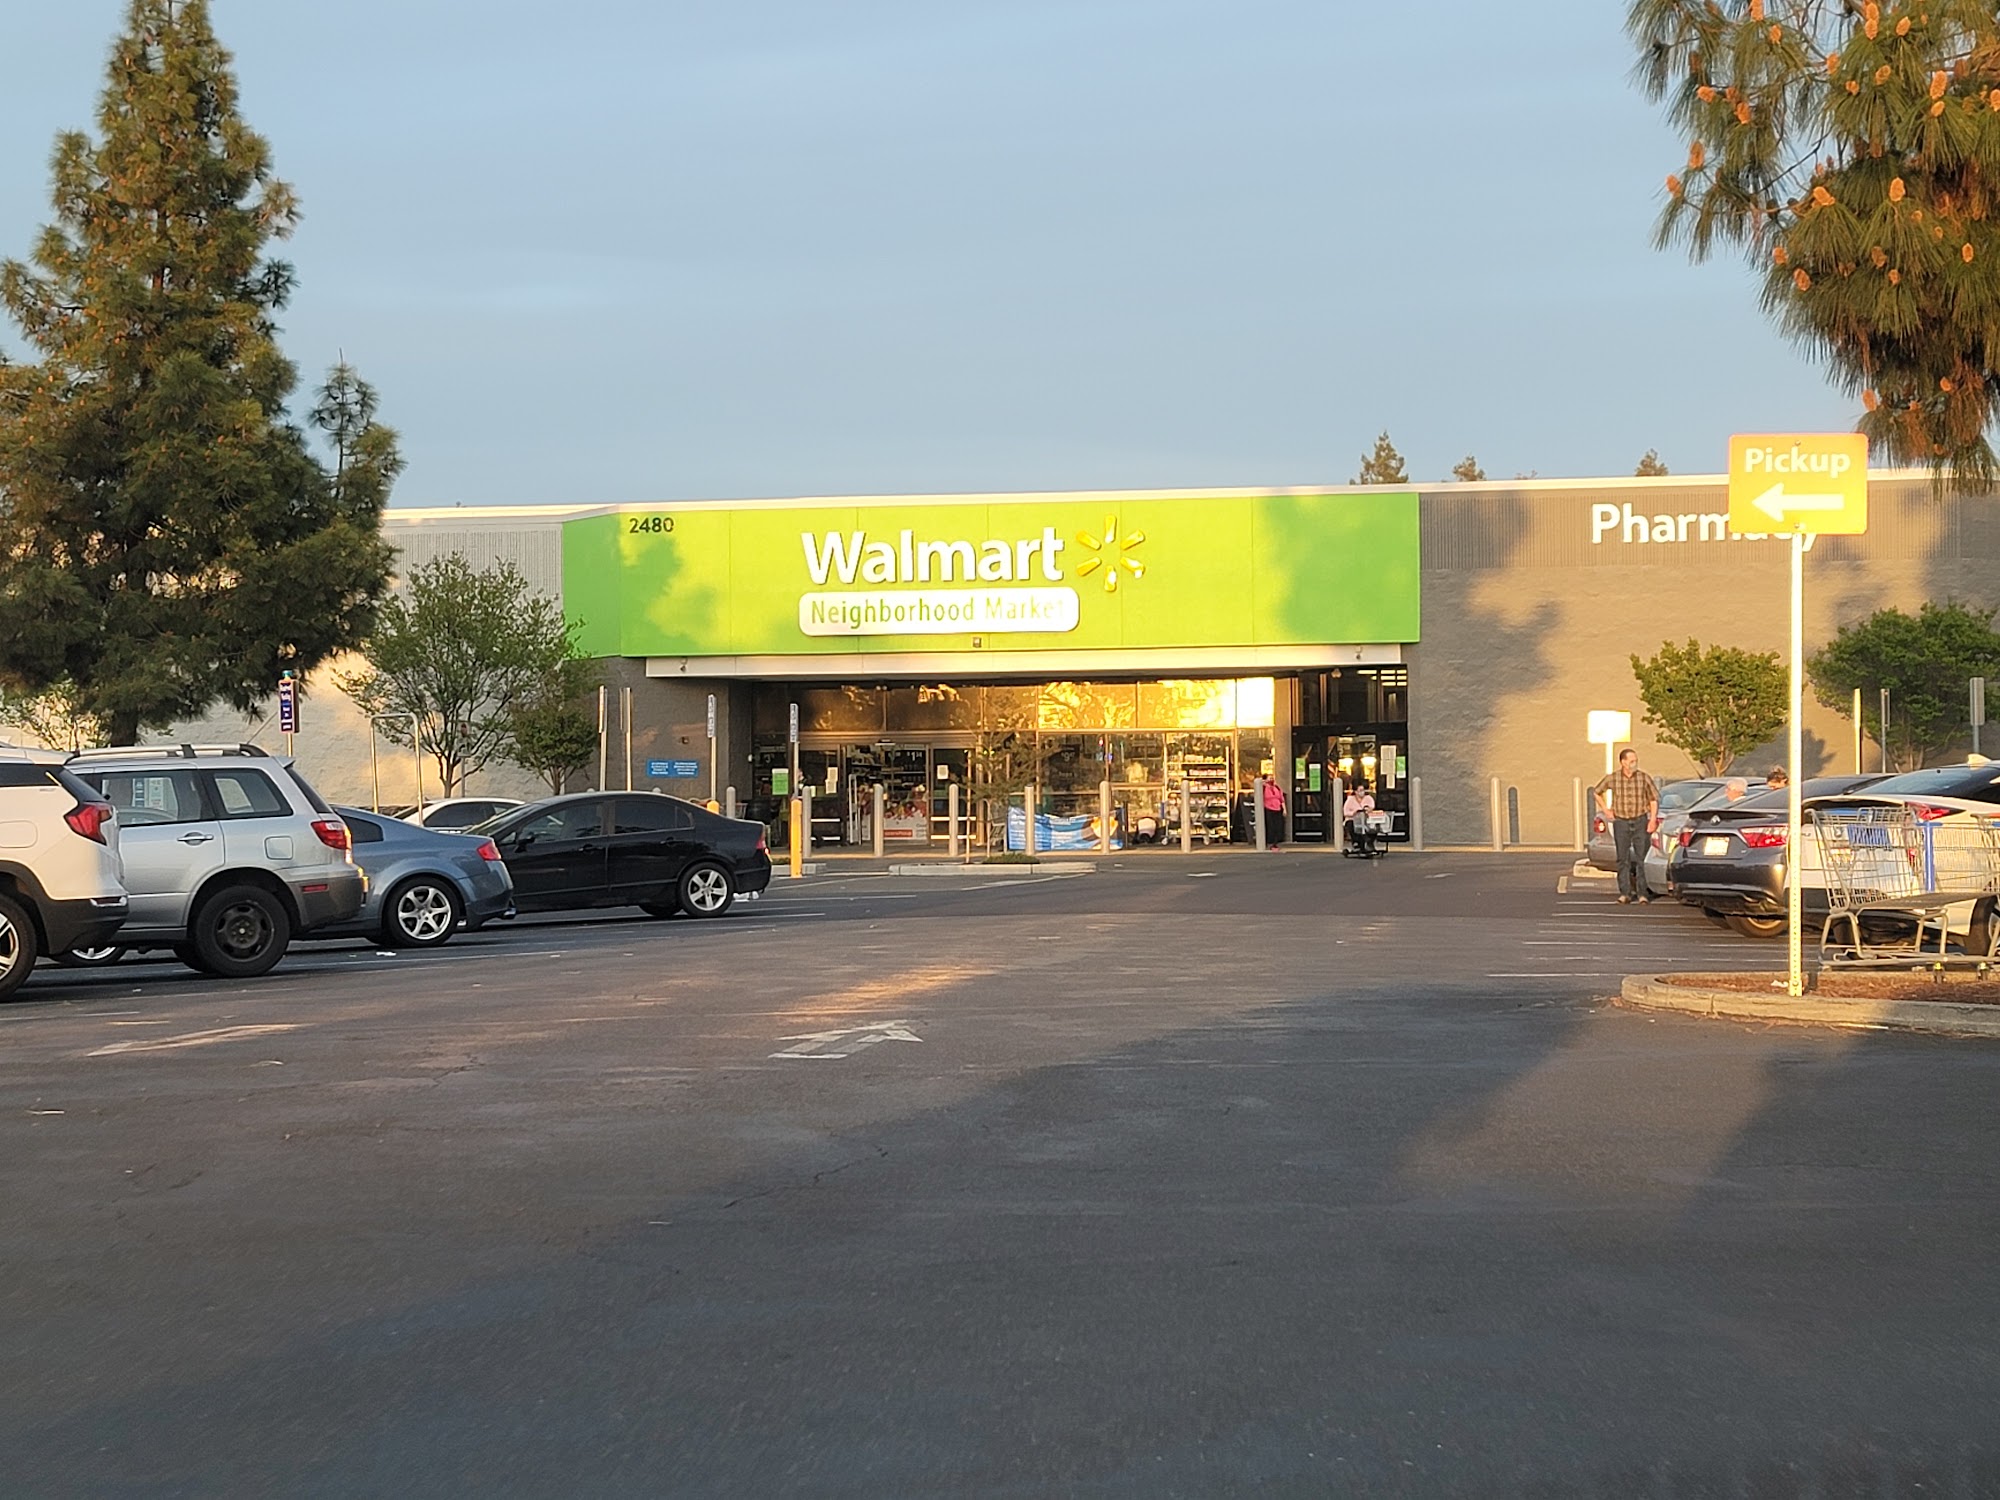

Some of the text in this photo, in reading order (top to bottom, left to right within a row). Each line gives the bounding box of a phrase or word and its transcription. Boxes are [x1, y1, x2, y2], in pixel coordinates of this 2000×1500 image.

[1745, 446, 1851, 479] Pickup
[629, 517, 674, 533] 2480
[1591, 502, 1816, 553] Pharm
[800, 526, 1065, 585] Walmart
[811, 597, 974, 630] Neighborhood
